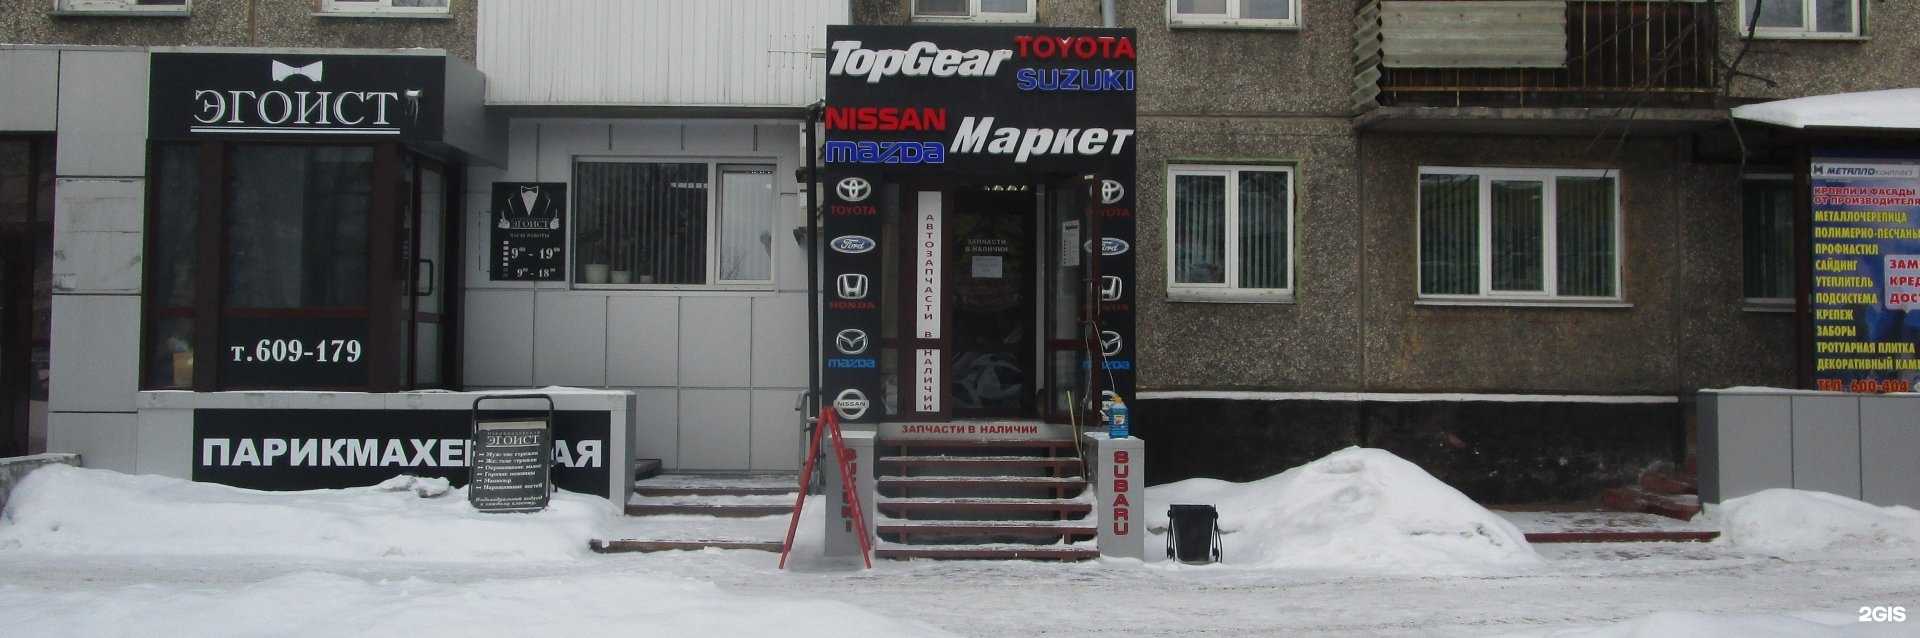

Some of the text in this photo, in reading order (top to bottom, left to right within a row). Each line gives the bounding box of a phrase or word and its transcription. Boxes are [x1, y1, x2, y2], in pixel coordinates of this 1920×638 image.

[1016, 35, 1135, 59] TOYOTA
[830, 40, 1012, 83] TopGear
[1016, 69, 1134, 91] SUZUKI
[193, 89, 399, 125] ЭГОИСТ
[826, 107, 945, 130] NISSAN
[949, 117, 1134, 163] Маркет
[1870, 188, 1915, 197] ФАСАДЫ
[831, 205, 876, 215] TOYOTA
[1815, 211, 1907, 224] МЕТАЛЛОЧЕРЕПИЦА
[841, 239, 865, 250] Ford
[1815, 243, 1879, 255] ПРОФНАСТИЛ
[924, 213, 935, 320] АВТОЗАПЧАСТИ
[1815, 258, 1858, 272] САЙДИНГ
[1889, 260, 1920, 269] ЗАМ
[1816, 276, 1873, 287] УТЕПЛИТЕЛЬ
[1816, 292, 1877, 304] ПОДСИСТЕМА
[1889, 293, 1920, 304] ДОС
[1816, 308, 1854, 320] КРЕПЕЖ
[1817, 325, 1856, 336] ЗАБОРЫ
[1817, 342, 1915, 353] ТРОТУАРНАЯ ПЛИТКА
[1817, 357, 1893, 371] ДЕКОРАТИВНЫЙ
[923, 350, 934, 411] НАЛИЧИИ
[902, 425, 1038, 434] ЗАПЧАСТИ В НАЛИЧИИ
[488, 435, 539, 445] ЭГОИСТ
[203, 438, 602, 468] ПАРИКМАХЕАЯ
[1113, 450, 1129, 536] SUBARU
